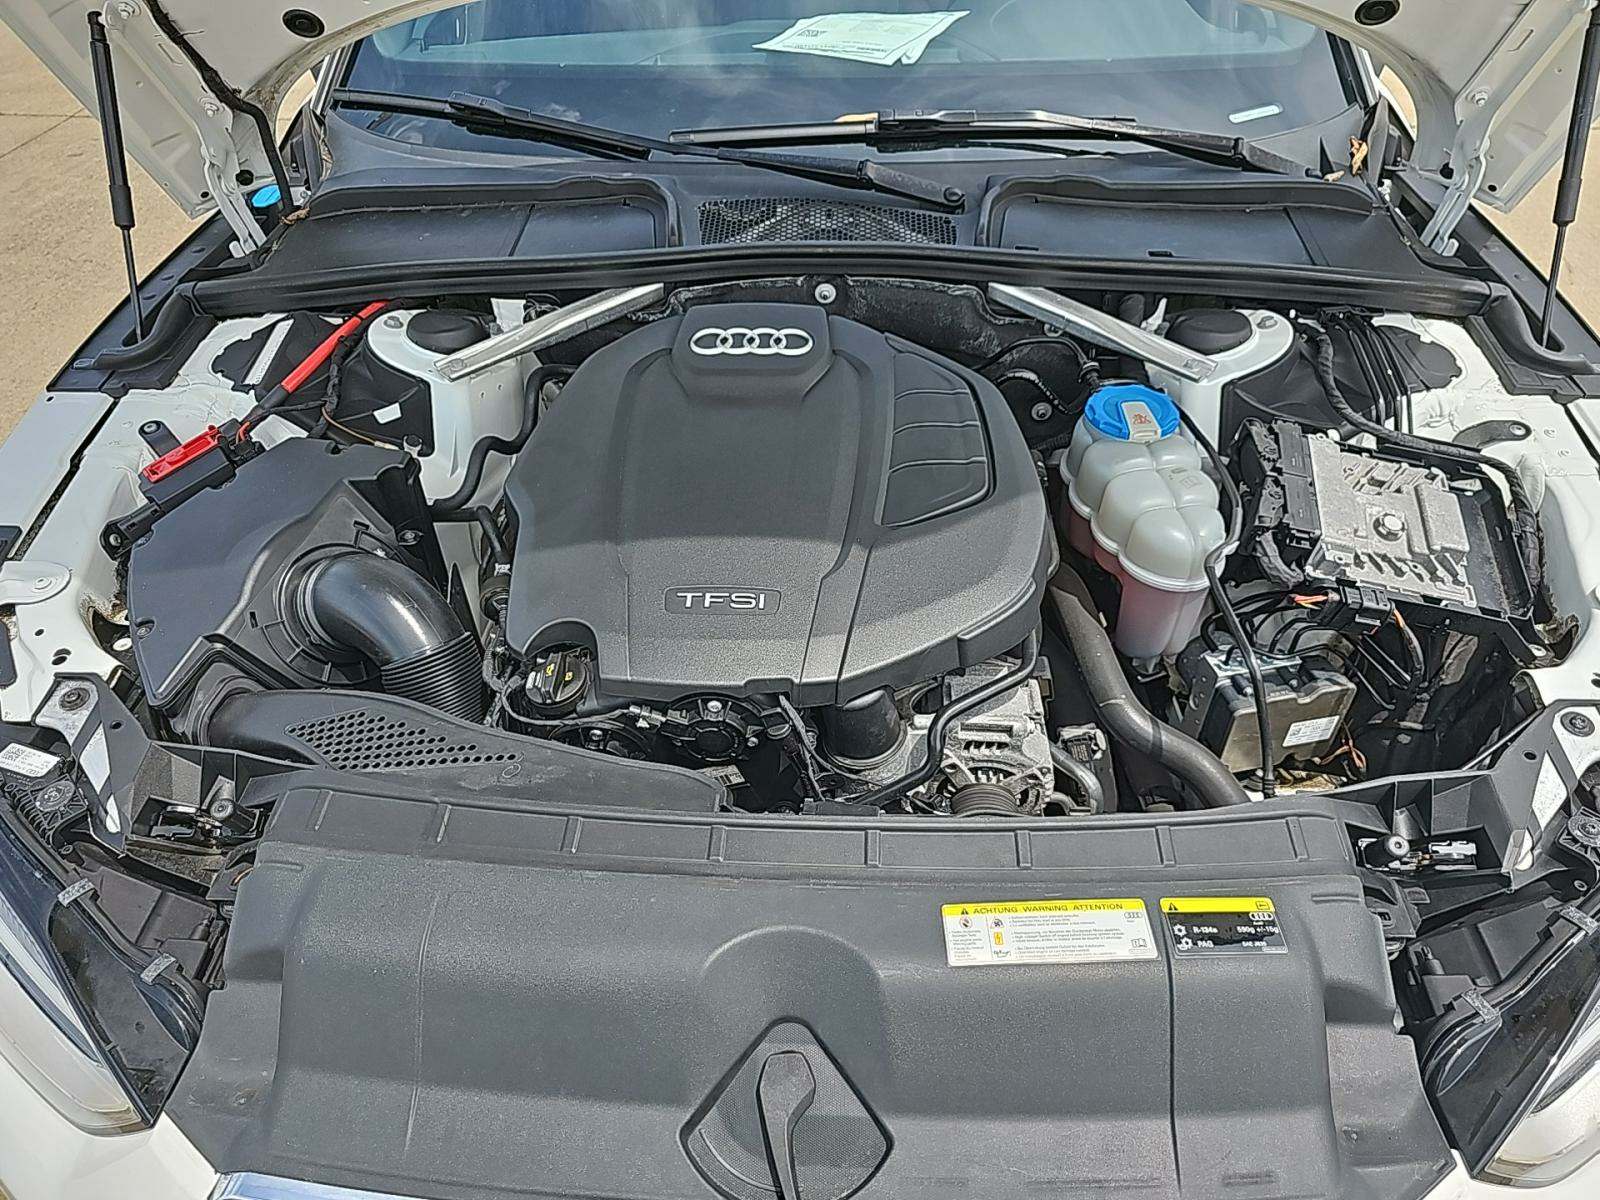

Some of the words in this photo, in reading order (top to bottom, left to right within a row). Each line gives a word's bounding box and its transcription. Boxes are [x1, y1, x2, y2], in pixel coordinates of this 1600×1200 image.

[676, 592, 766, 610] TFSI
[973, 906, 1018, 914] ACHTUNG
[1023, 904, 1068, 913] WARNING
[1073, 903, 1123, 912] ATTENTION
